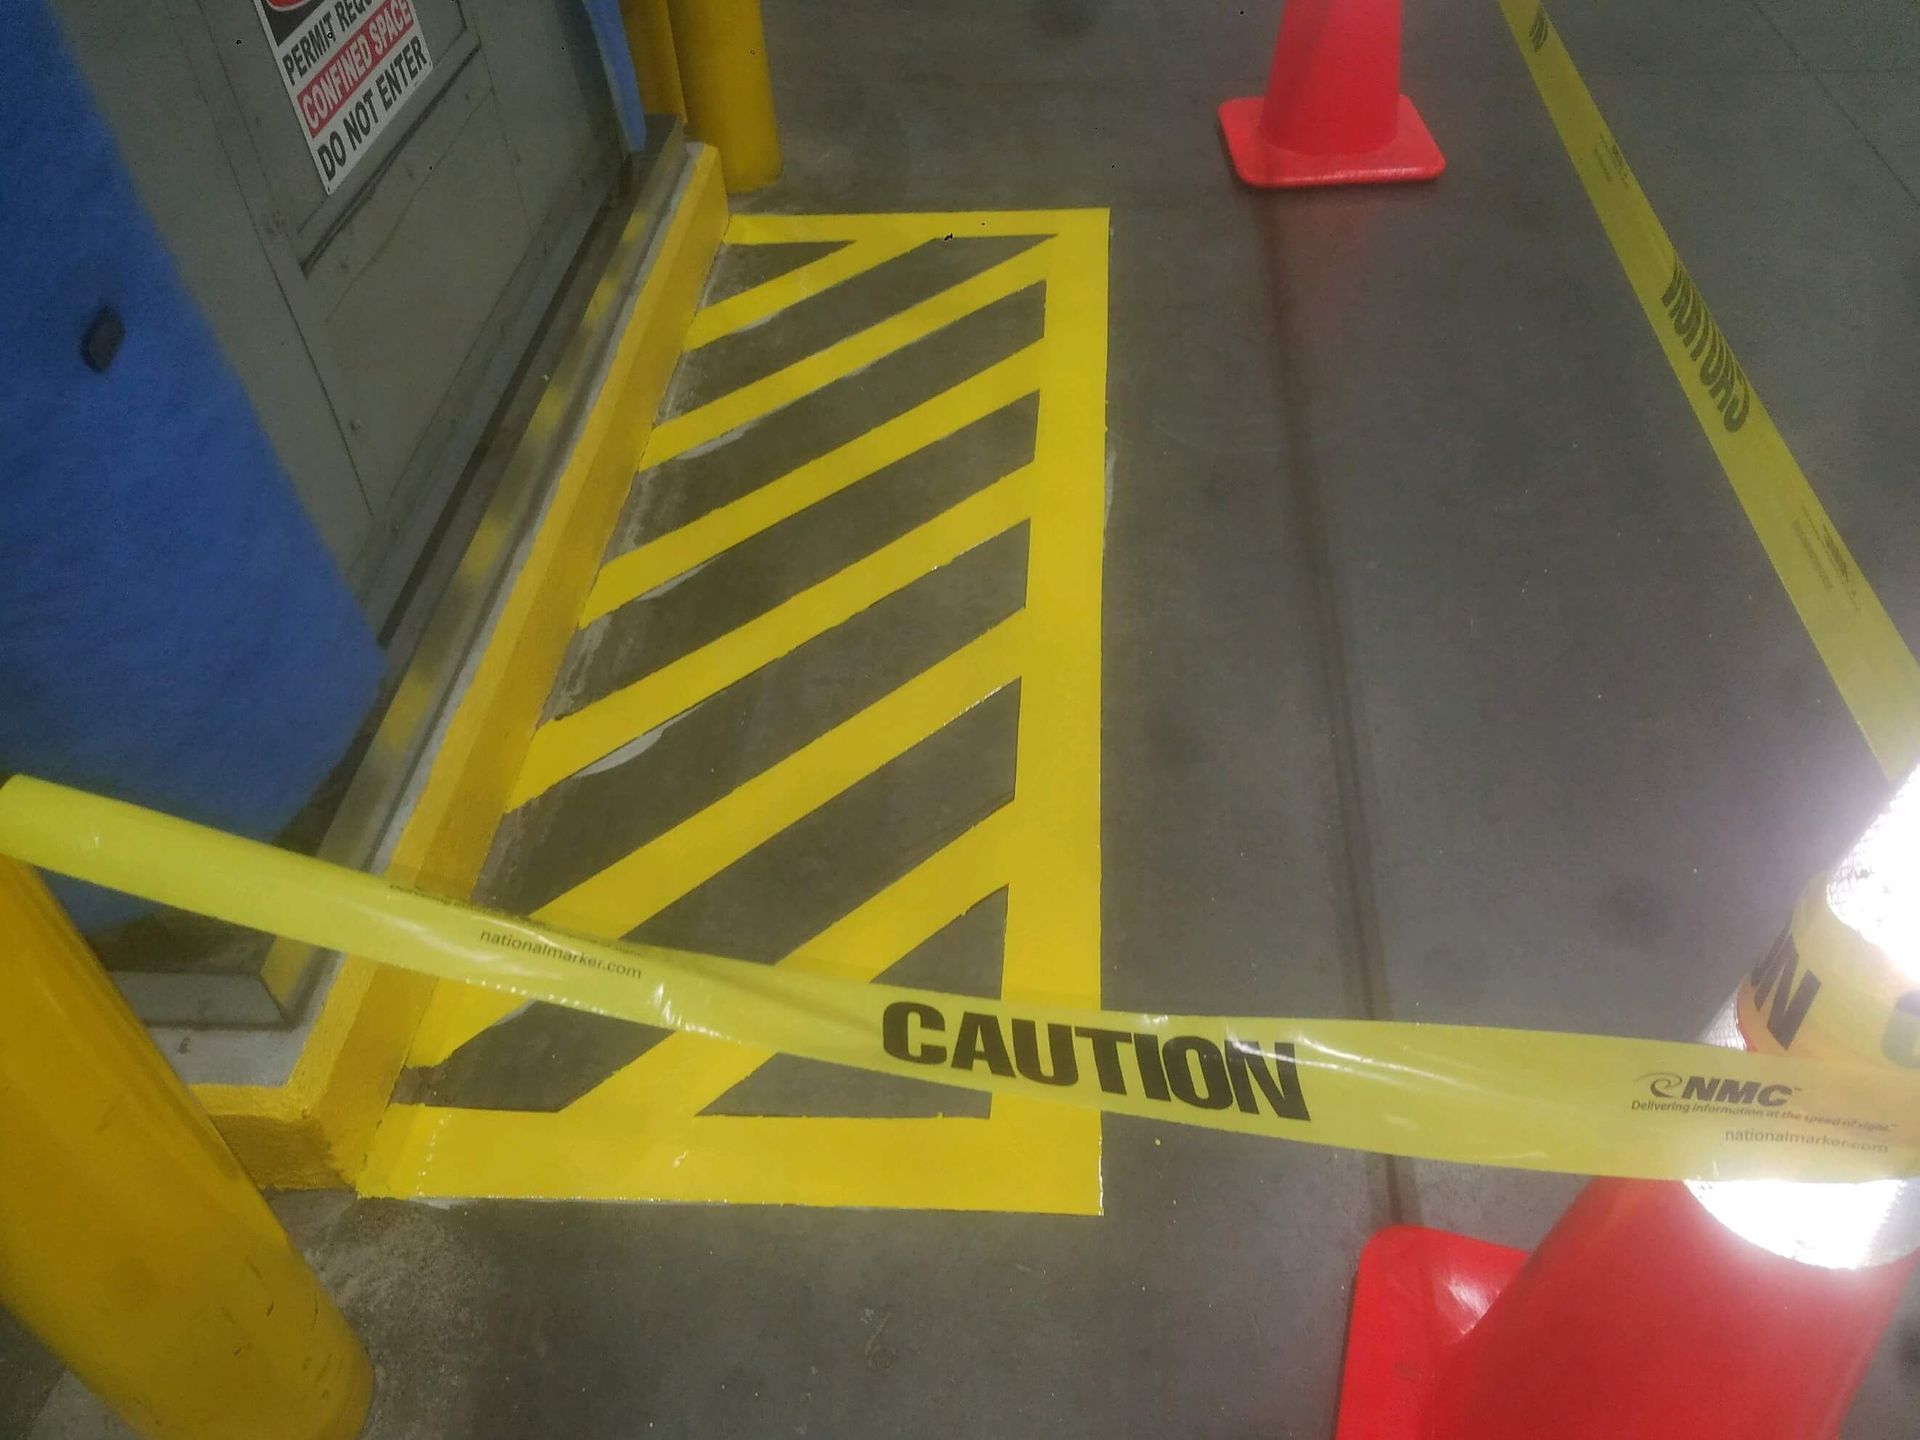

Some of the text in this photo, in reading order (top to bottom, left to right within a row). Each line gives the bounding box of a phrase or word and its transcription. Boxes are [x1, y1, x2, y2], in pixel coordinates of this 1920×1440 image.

[282, 11, 337, 86] PERMIT
[302, 0, 414, 129] CONFINED SPACE
[317, 35, 428, 182] DO NOT ENTER
[480, 929, 643, 979] nationalmarker.com
[882, 1001, 1311, 1122] CAUTION
[1631, 1099, 1690, 1113] Delivering
[1692, 1103, 1765, 1116] information
[1725, 1127, 1888, 1153] nationalmarker.com
